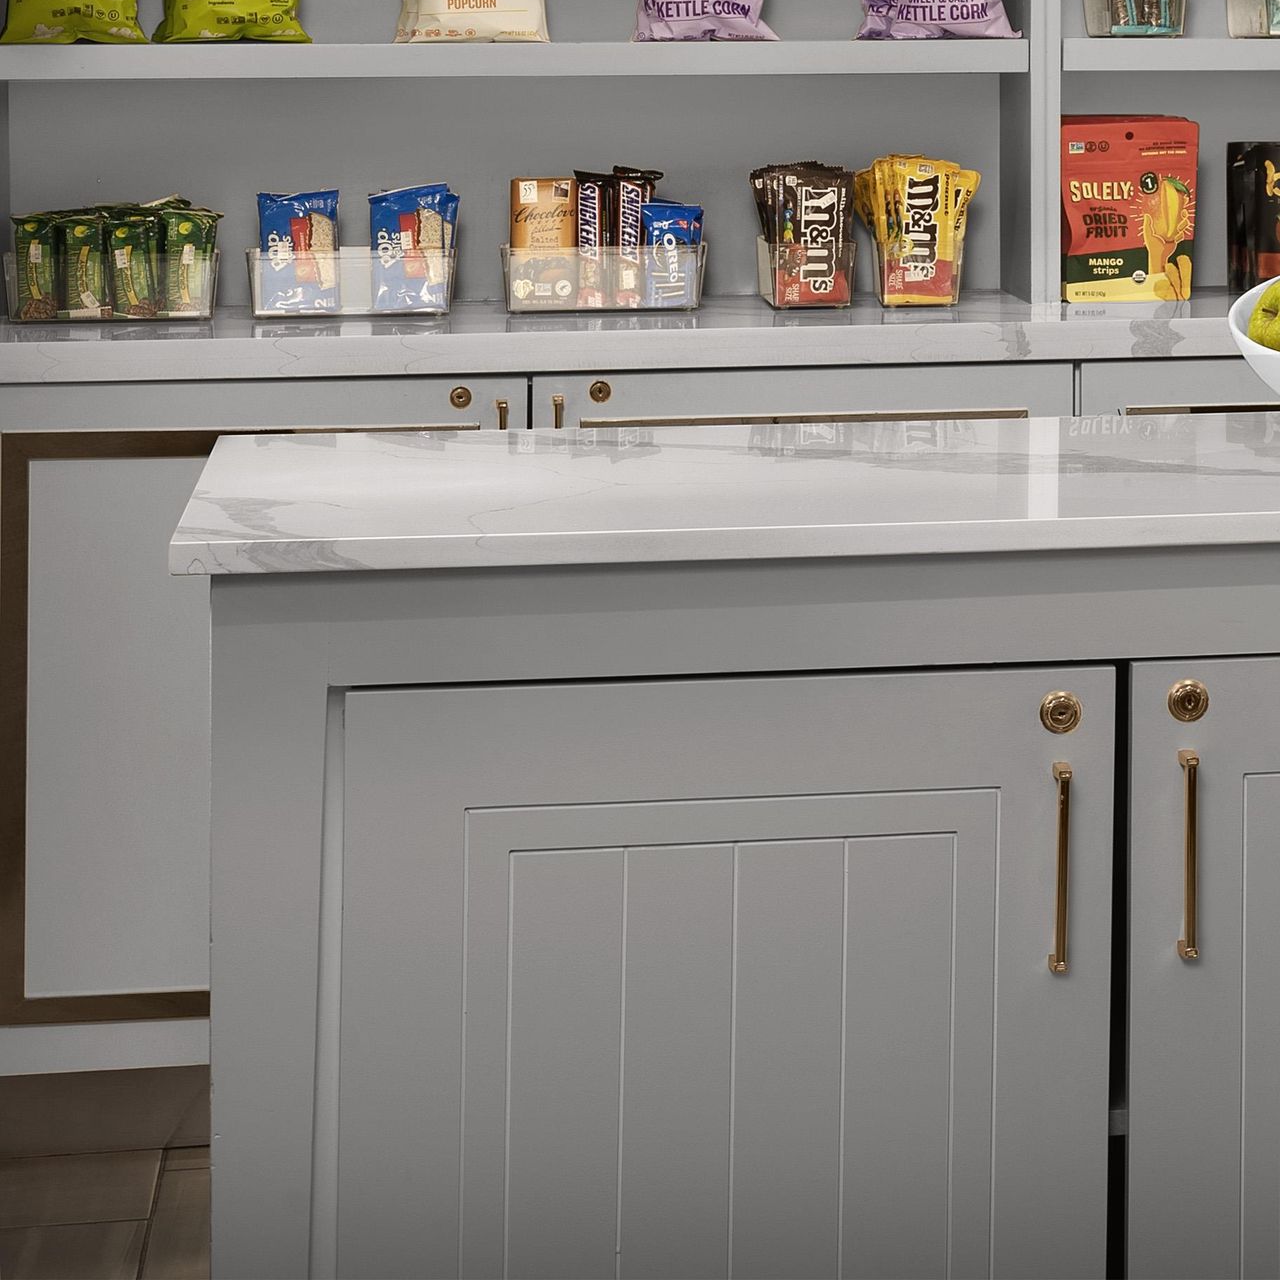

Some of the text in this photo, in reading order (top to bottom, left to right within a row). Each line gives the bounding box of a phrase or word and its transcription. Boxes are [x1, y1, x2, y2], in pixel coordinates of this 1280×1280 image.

[657, 0, 750, 19] KETTLE CORN
[898, 2, 989, 21] KETTLE CORN
[514, 204, 576, 224] Chocolove
[579, 183, 599, 260] SNICKERS
[620, 182, 641, 263] SNICKERS
[1083, 213, 1128, 226] DRIED
[1086, 226, 1128, 239] FRUIT
[663, 232, 678, 283] OREO
[1089, 258, 1123, 266] MANGO
[1093, 266, 1119, 275] strips
